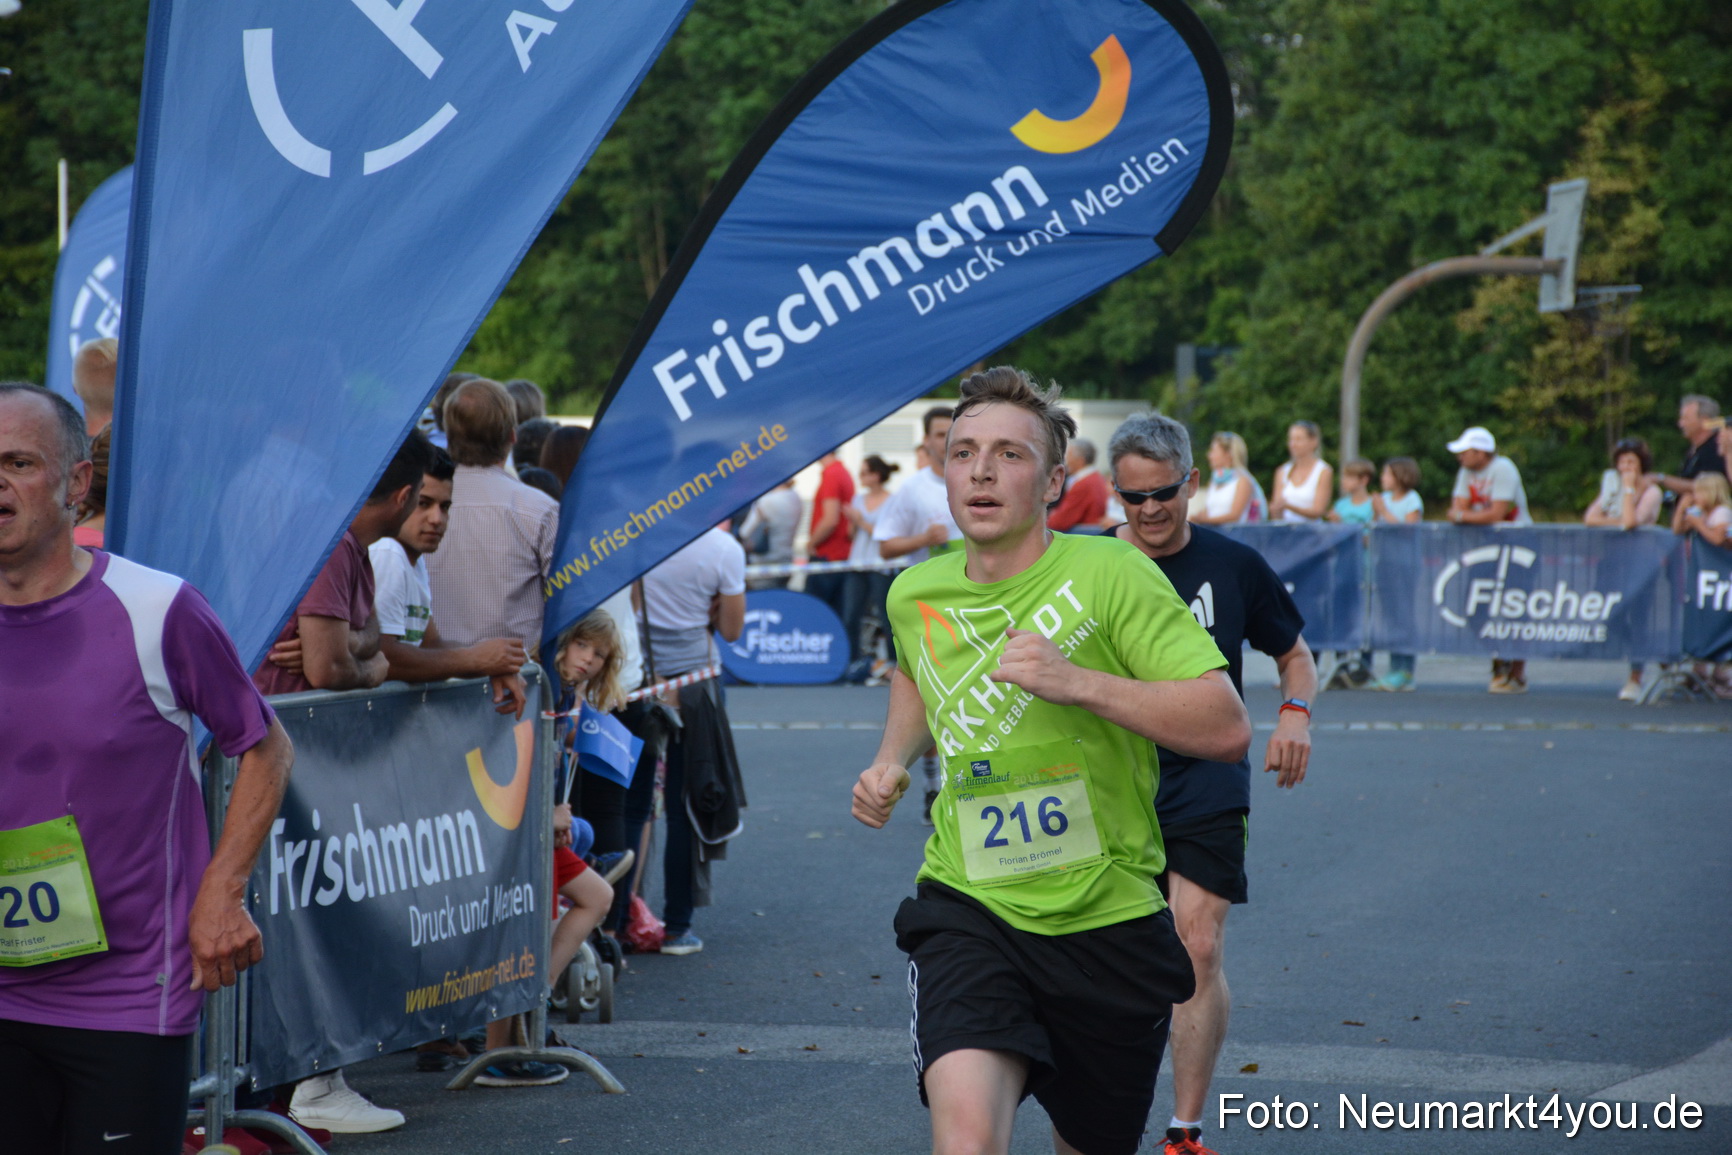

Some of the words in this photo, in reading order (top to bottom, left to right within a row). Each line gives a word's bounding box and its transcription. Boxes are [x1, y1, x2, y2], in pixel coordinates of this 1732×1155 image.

[908, 245, 1004, 316] Druck
[1007, 210, 1070, 256] und
[1070, 137, 1190, 226] Medien
[652, 165, 1049, 422] Frischmann
[1466, 578, 1622, 621] Fischer
[746, 627, 834, 653] Fischer
[1480, 621, 1608, 643] AUTOMOBILE
[938, 579, 1083, 760] RKHDT
[966, 771, 1010, 787] firmenlauf
[981, 796, 1069, 849] 216
[269, 802, 486, 916] Frischmann
[999, 855, 1029, 867] Florian
[1029, 846, 1063, 862] Brömel
[409, 895, 457, 947] Druck
[459, 886, 490, 935] und
[492, 876, 535, 926] Meien
[15, 935, 46, 948] Frister
